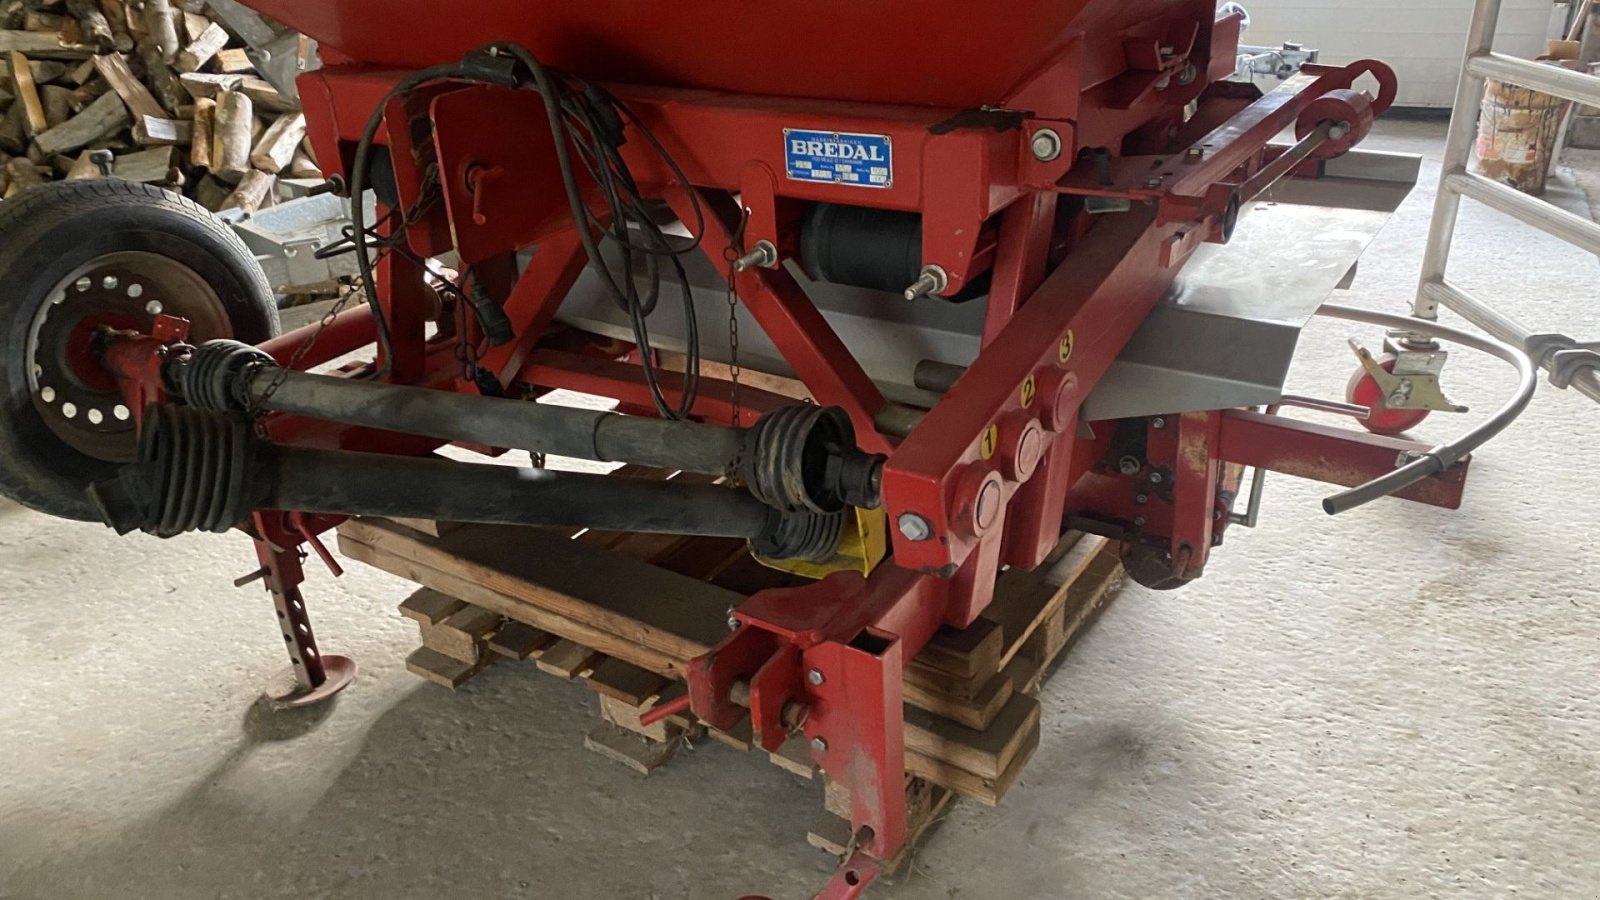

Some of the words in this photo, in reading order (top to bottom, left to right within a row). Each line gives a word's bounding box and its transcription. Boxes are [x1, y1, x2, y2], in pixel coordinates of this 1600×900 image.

[791, 139, 884, 161] BREDAL
[1060, 336, 1071, 359] 3
[1023, 378, 1033, 407] 2
[984, 429, 993, 454] 1
